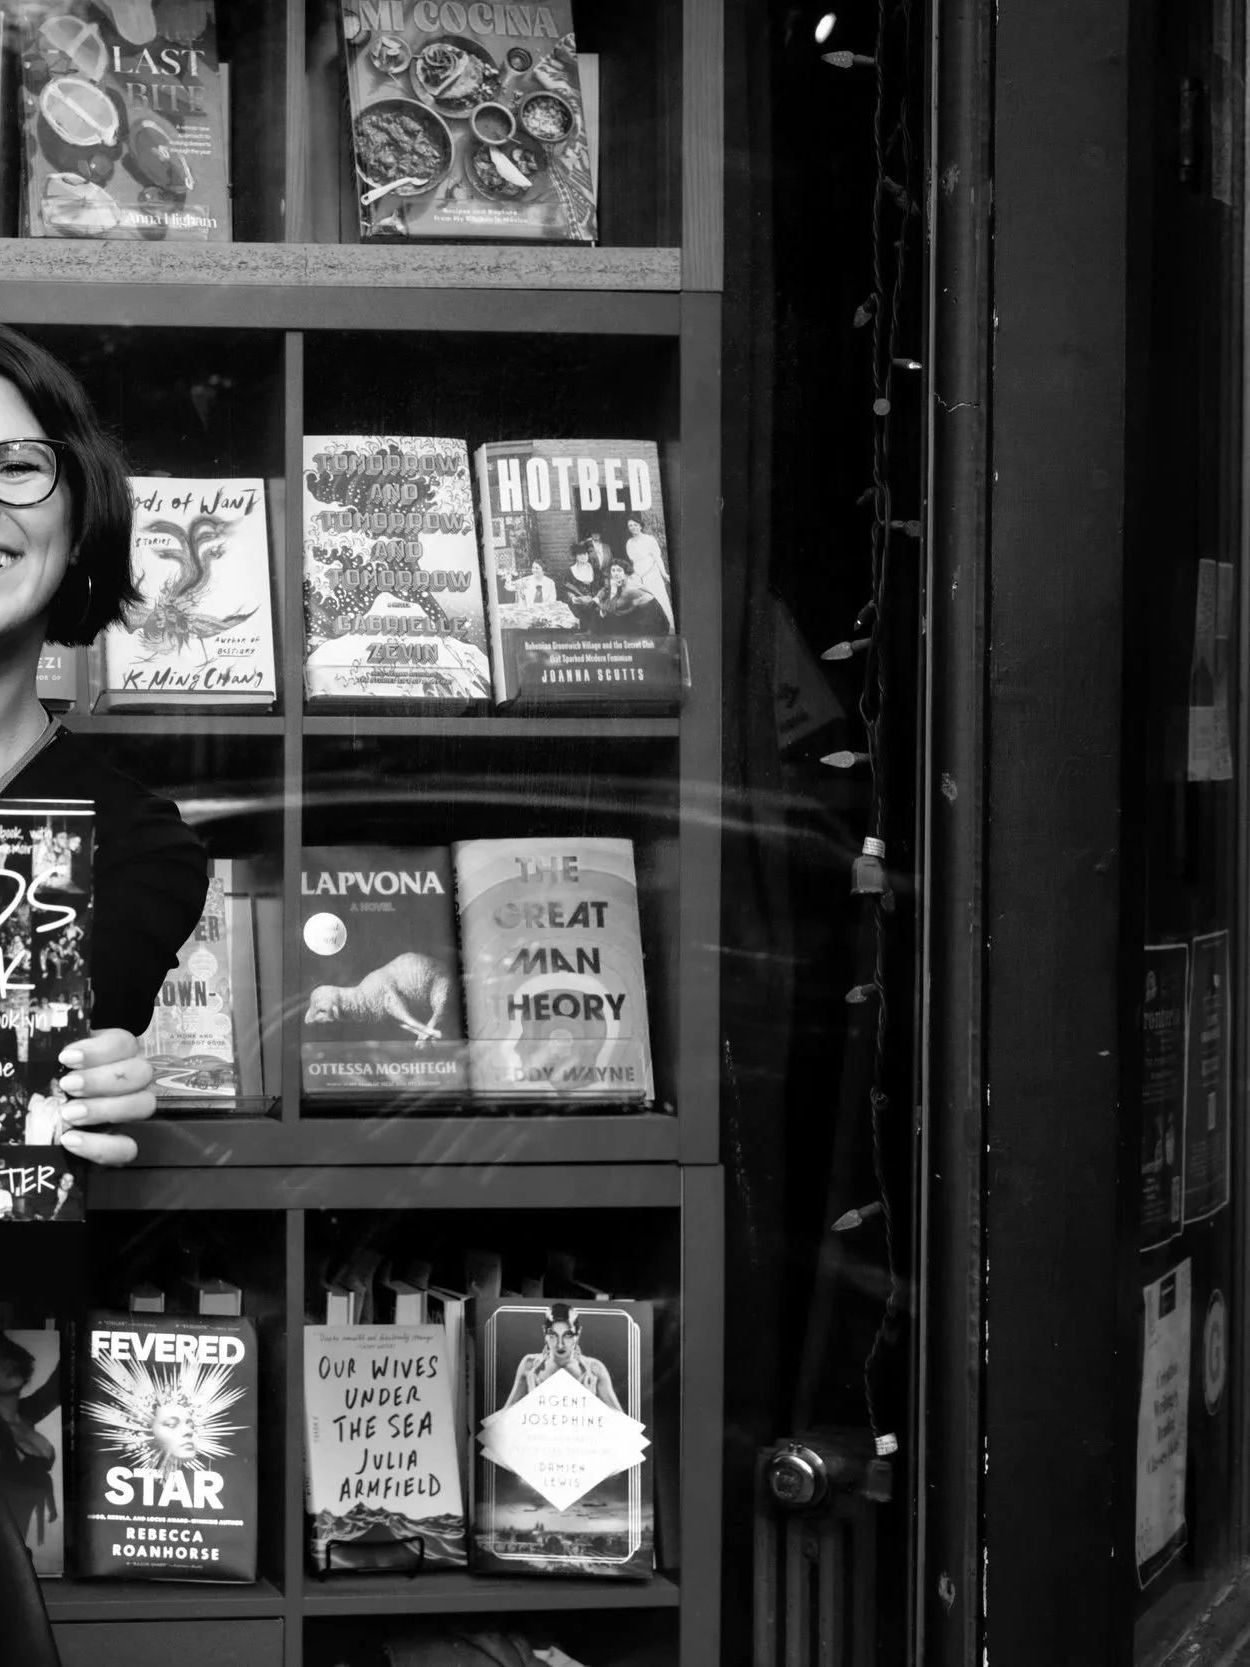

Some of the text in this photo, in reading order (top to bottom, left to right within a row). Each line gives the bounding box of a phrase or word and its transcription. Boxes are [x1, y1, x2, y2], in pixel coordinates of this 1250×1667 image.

[358, 0, 559, 38] MI COCINA
[112, 46, 206, 76] LAST
[126, 82, 207, 114] BITE
[126, 211, 217, 229] Anna Higham
[370, 482, 419, 505] AND
[497, 457, 652, 513] HOTBED
[133, 490, 161, 512] ods
[172, 491, 195, 515] of
[135, 537, 171, 547] STORIES
[371, 541, 424, 563] AND
[325, 569, 472, 593] TOMORROW
[332, 615, 470, 637] GABRIELLE
[214, 636, 261, 645] AUTHOR OF
[524, 641, 551, 650] Bohemian
[552, 640, 581, 650] Greenwich
[582, 640, 601, 651] Village
[602, 641, 612, 650] and
[613, 641, 623, 649] the
[623, 640, 641, 649] Secret
[365, 642, 440, 665] ZEVIN
[562, 653, 584, 664] Sparked
[585, 653, 606, 663] Modern
[607, 652, 633, 663] Feminism
[541, 668, 645, 683] JOANNA SCUTTS
[515, 855, 580, 884] THE
[301, 870, 445, 896] LAPVONA
[350, 901, 396, 912] A NOVEL
[493, 900, 609, 930] GREAT
[507, 946, 602, 975] MAN
[506, 993, 627, 1021] HEORY
[308, 1061, 457, 1076] OTTESSA MOSHFEGH
[562, 1065, 636, 1083] WAYNE
[90, 1330, 246, 1365] FEVERED
[318, 1355, 439, 1380] OUR WIVES
[344, 1385, 421, 1410] UNDER
[538, 1394, 587, 1408] AGENT
[333, 1414, 378, 1443] THE
[387, 1410, 433, 1439] SEA
[521, 1412, 604, 1428] JOSEPHINE
[355, 1448, 419, 1475] JULIA
[539, 1461, 586, 1474] DAMIEN
[104, 1466, 225, 1510] STAR
[339, 1473, 442, 1503] ARMFIELD
[544, 1476, 580, 1488] LEWIS
[126, 1527, 204, 1543] REBECCA
[112, 1544, 220, 1561] ROANHORSE
